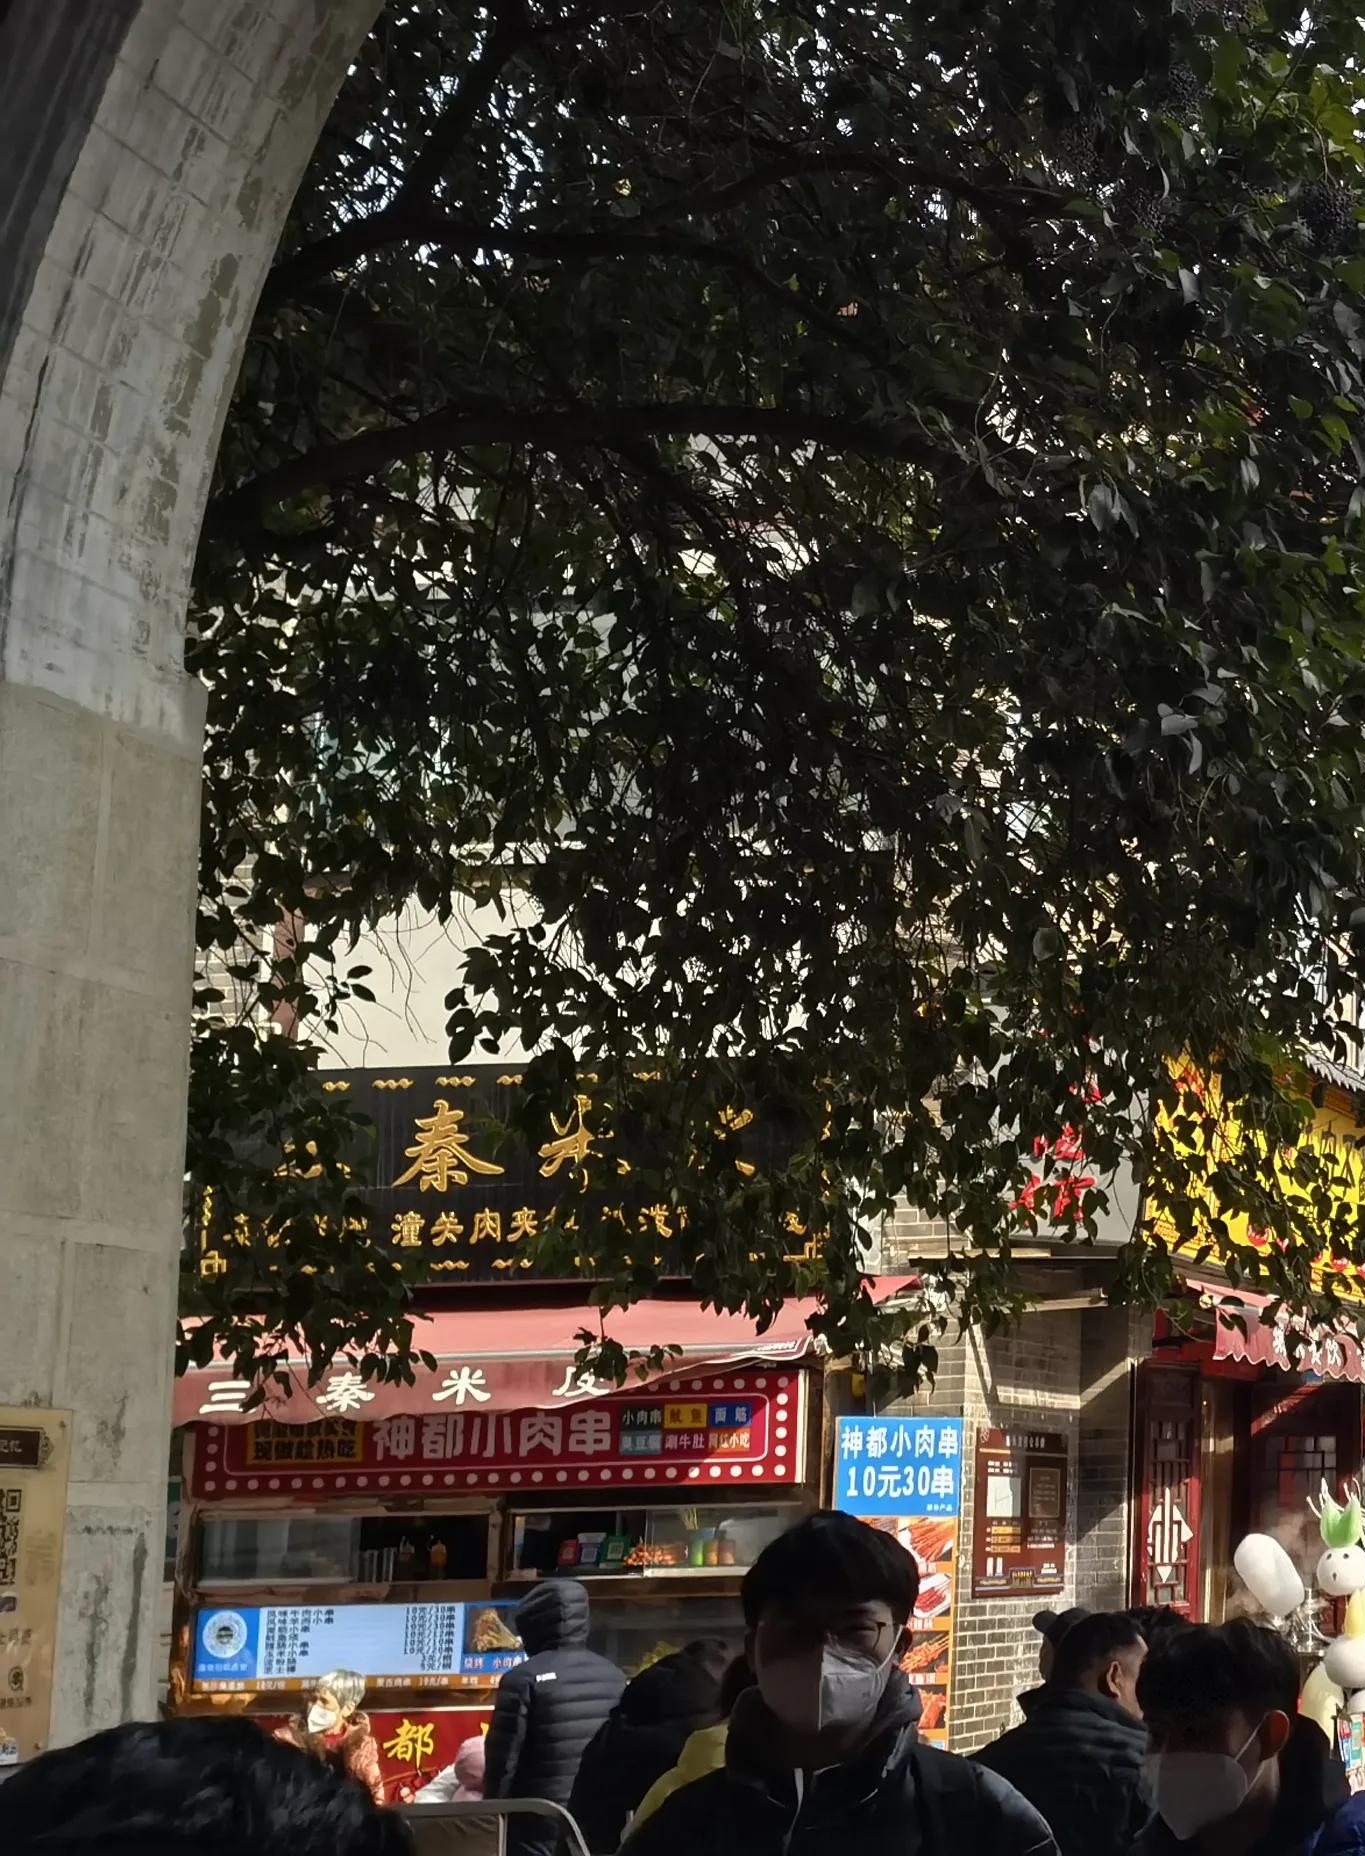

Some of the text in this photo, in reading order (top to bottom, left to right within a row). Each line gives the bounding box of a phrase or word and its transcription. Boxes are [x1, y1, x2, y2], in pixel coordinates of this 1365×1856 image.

[371, 1409, 612, 1460] 神都小肉串
[840, 1424, 960, 1460] 神都小肉串
[846, 1464, 955, 1499] 10元30串
[382, 1718, 435, 1768] 都
